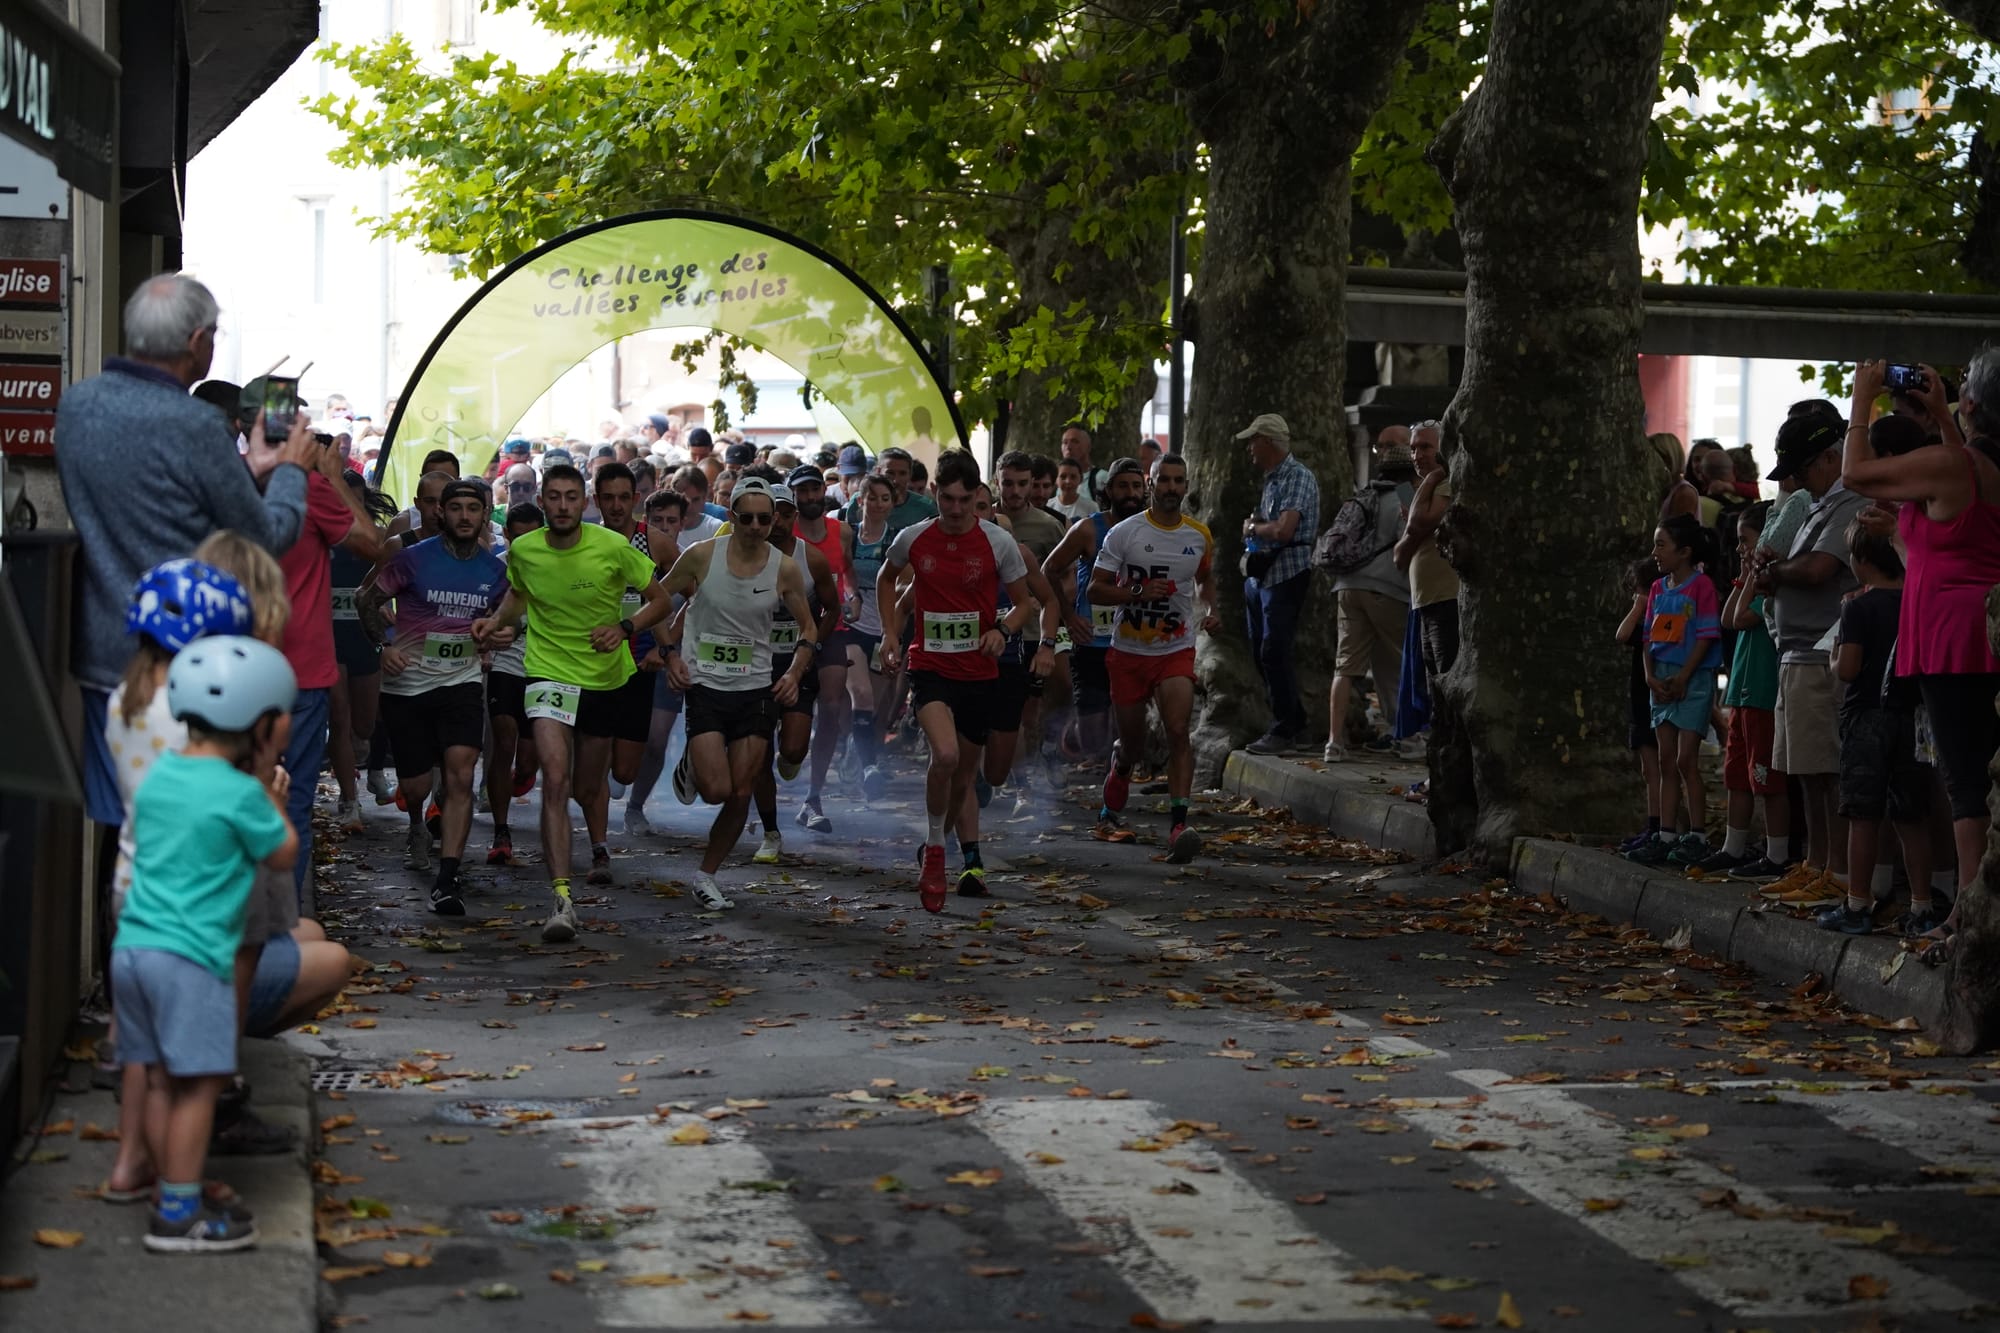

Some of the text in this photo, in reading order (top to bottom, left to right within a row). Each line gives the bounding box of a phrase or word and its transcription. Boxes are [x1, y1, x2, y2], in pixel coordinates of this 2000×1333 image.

[547, 252, 768, 290] Challenge des
[533, 277, 788, 317] vallées cévenoles
[0, 379, 52, 399] urre
[427, 589, 489, 609] MARVEJOLS
[437, 603, 476, 619] MENDE
[1121, 608, 1181, 632] NTS
[1663, 619, 1672, 631] 4
[771, 629, 794, 643] 71
[932, 623, 972, 640] 113
[438, 643, 463, 658] 60
[713, 646, 739, 663] 53
